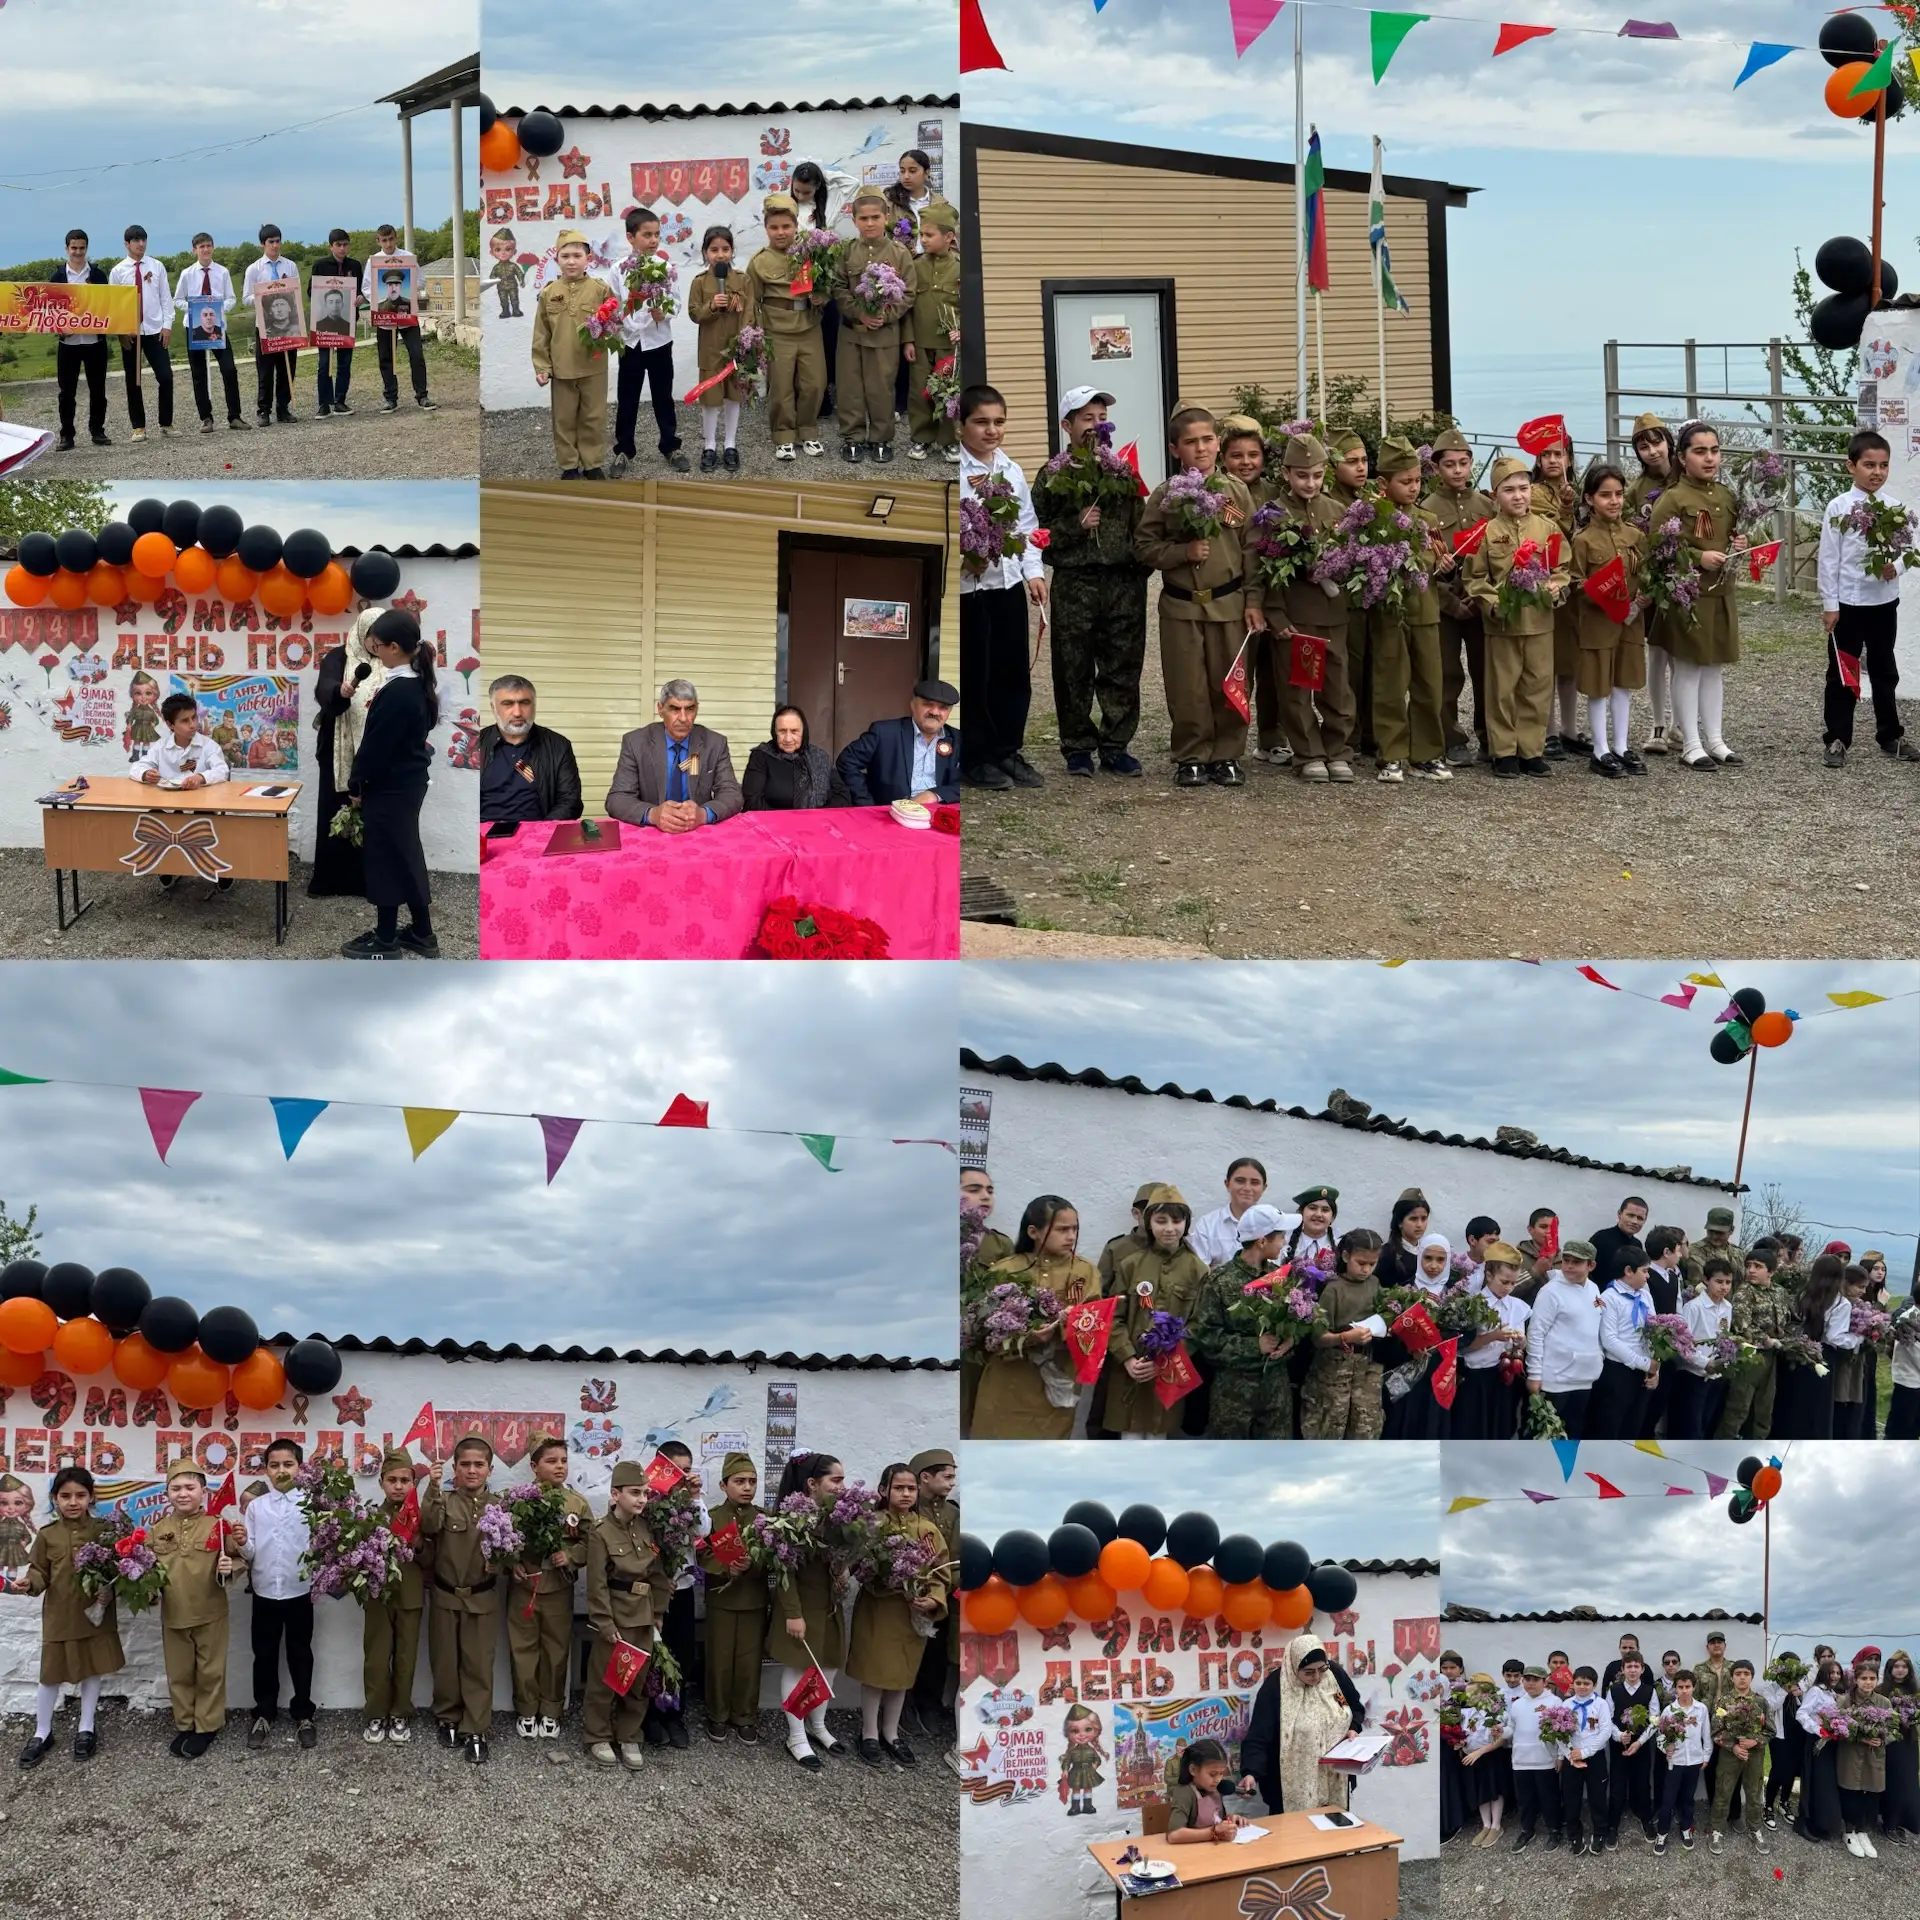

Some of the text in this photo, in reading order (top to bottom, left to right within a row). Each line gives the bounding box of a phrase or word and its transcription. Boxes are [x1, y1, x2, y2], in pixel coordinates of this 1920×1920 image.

[480, 183, 613, 225] БЕДЫ
[28, 312, 109, 329] Победы
[154, 587, 187, 635] 9
[112, 633, 225, 672] ДЕНЬ
[81, 687, 115, 701] 9 МАЯ
[218, 688, 228, 701] С
[85, 709, 115, 718] ВЕЛИКОЙ
[30, 1371, 77, 1429] 9
[0, 1426, 124, 1476] ЕНЬ
[709, 1441, 746, 1450] ПОБЕДА
[1091, 1606, 1131, 1659] 9
[1040, 1640, 1376, 1706] ДЕНЬ ПОБЫ
[1169, 1715, 1181, 1729] С
[999, 1731, 1044, 1746] 9 МАЯ
[1008, 1748, 1015, 1758] С
[1006, 1756, 1046, 1768] ВЕЛИКОЙ
[1006, 1767, 1047, 1779] ПОБЕДЫ!
